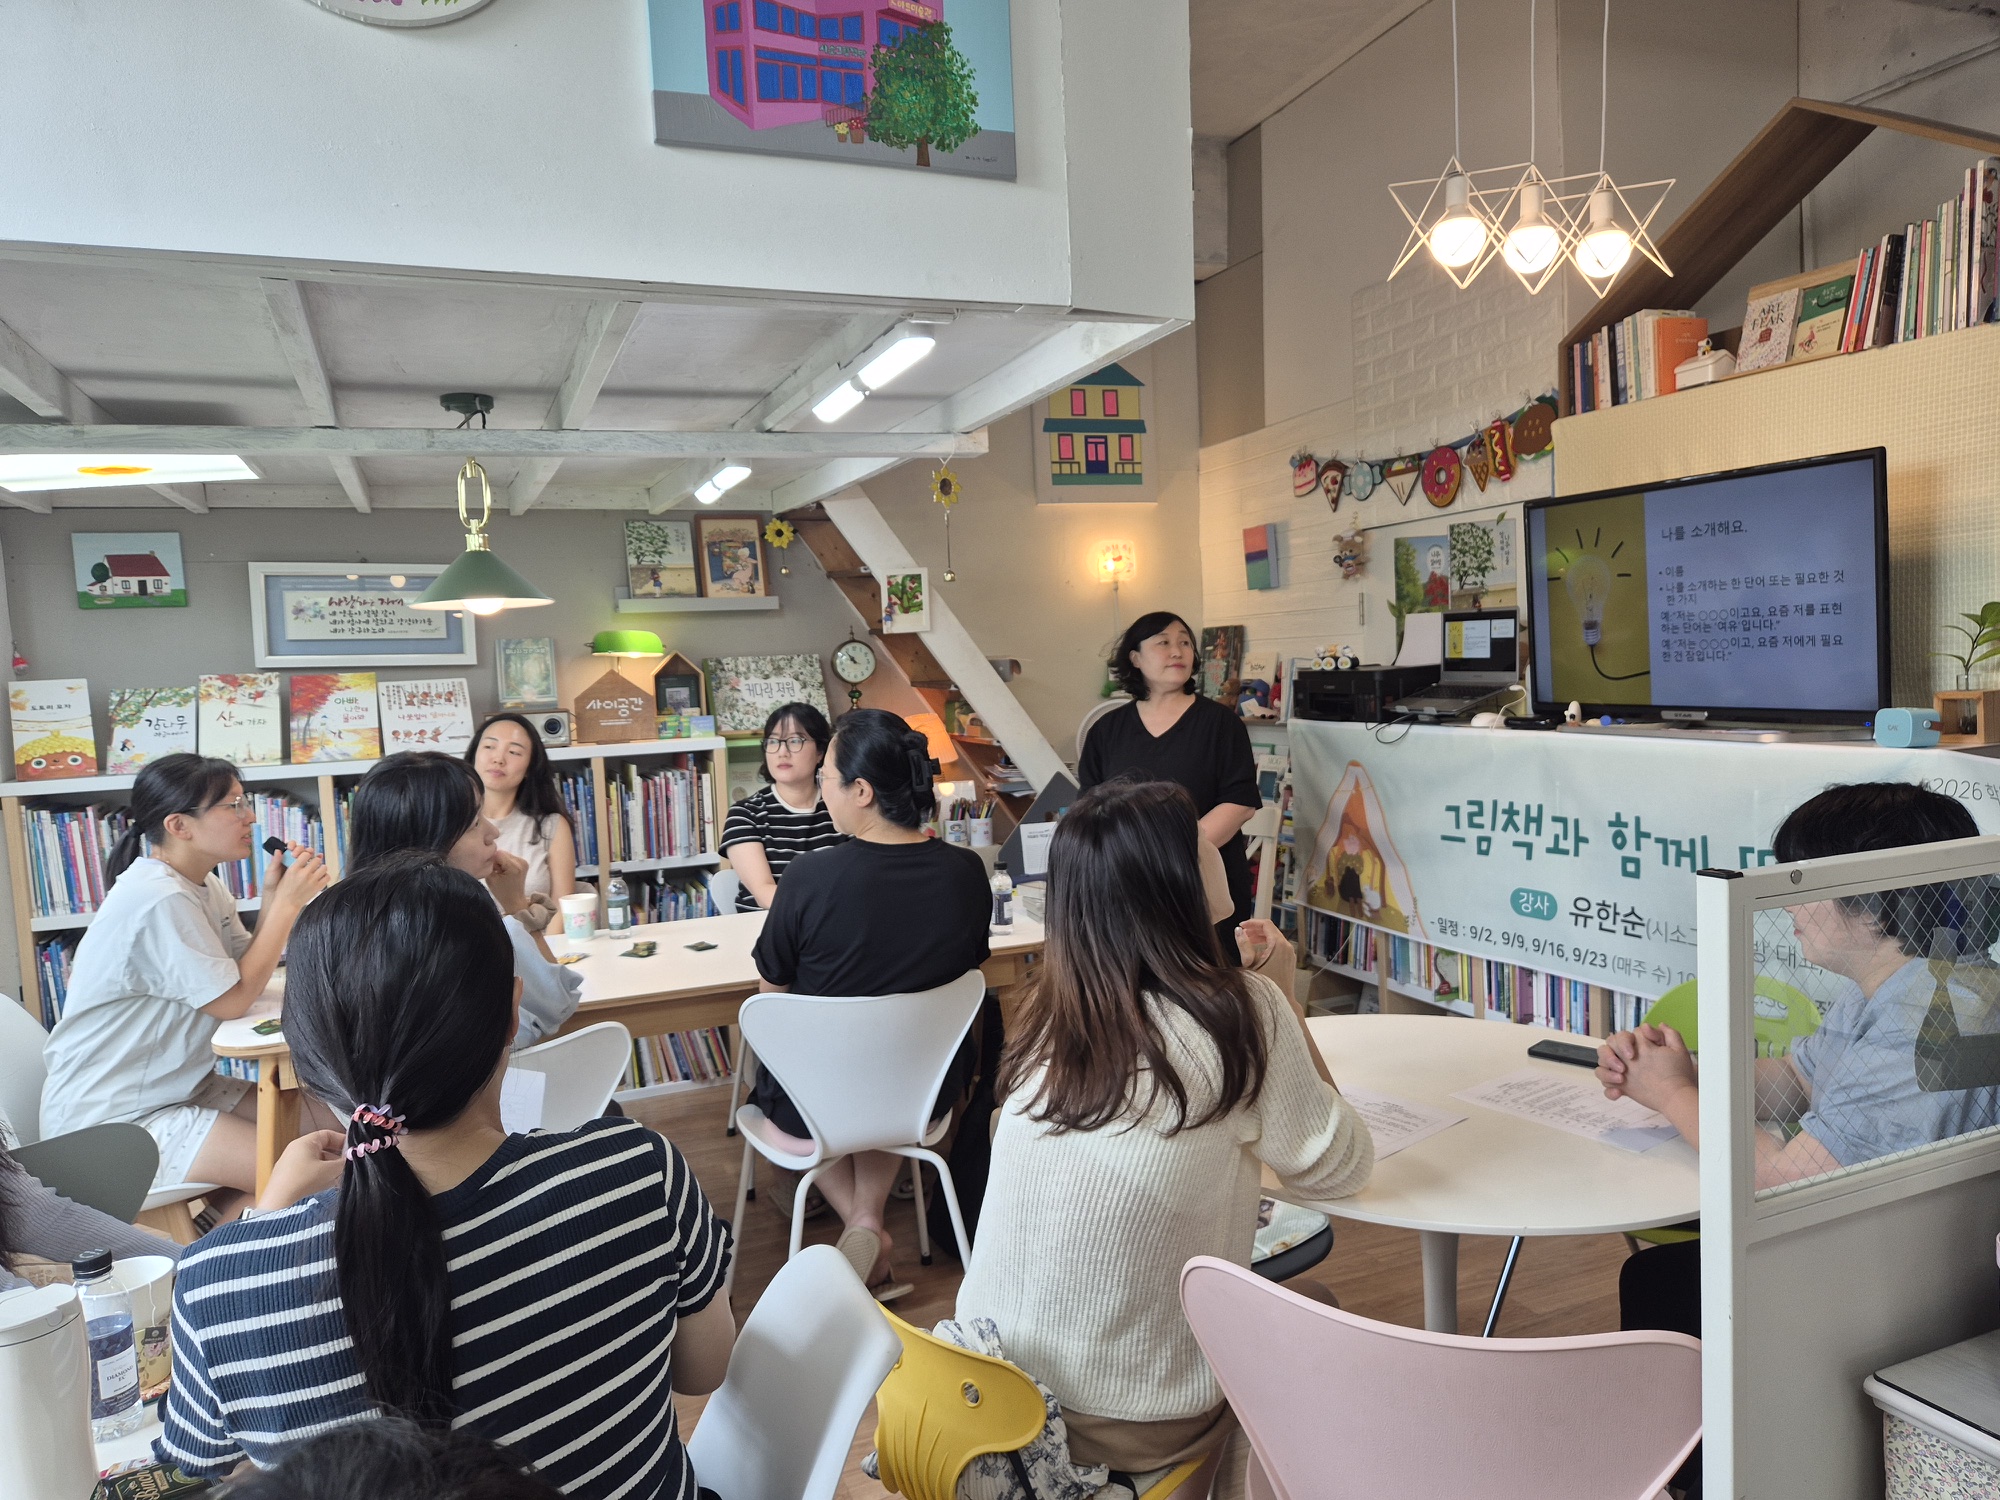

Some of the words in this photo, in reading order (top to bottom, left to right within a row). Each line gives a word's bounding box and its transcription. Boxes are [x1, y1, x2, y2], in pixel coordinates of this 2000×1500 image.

[1661, 525, 1685, 541] 나를
[1690, 520, 1748, 538] 소개해요.
[1665, 565, 1684, 578] 이름
[1665, 581, 1684, 594] 나를
[1687, 579, 1728, 593] 소개하는
[1731, 577, 1741, 590] 한
[1744, 575, 1766, 589] 단어
[1769, 574, 1791, 586] 또는
[1795, 571, 1829, 585] 필요한
[1833, 569, 1845, 584] 것
[1666, 594, 1675, 606] 한
[1678, 592, 1698, 605] 가지
[1768, 604, 1790, 617] 요즘
[1793, 603, 1816, 617] 저를
[1819, 602, 1843, 616] 표현
[1661, 622, 1680, 635] 하는
[1683, 621, 1712, 634] 단어는
[1757, 635, 1779, 649] 요즘
[1782, 634, 1817, 648] 저에게
[1820, 633, 1844, 648] 필요
[1662, 651, 1671, 663] 한
[1674, 650, 1683, 663] 건
[744, 682, 775, 699] 커다란
[775, 681, 796, 698] 정원
[586, 697, 644, 717] 사이공간
[1440, 799, 1590, 861] 그림책과
[1607, 811, 1709, 879] 함께
[1517, 891, 1550, 917] 강사
[1469, 925, 1498, 946] 9/2,
[1501, 931, 1529, 952] 9/9,
[1532, 938, 1569, 963] 9/16,
[1572, 947, 1608, 969] 9/23
[1611, 955, 1648, 978] (매주
[1651, 965, 1672, 986] 수)
